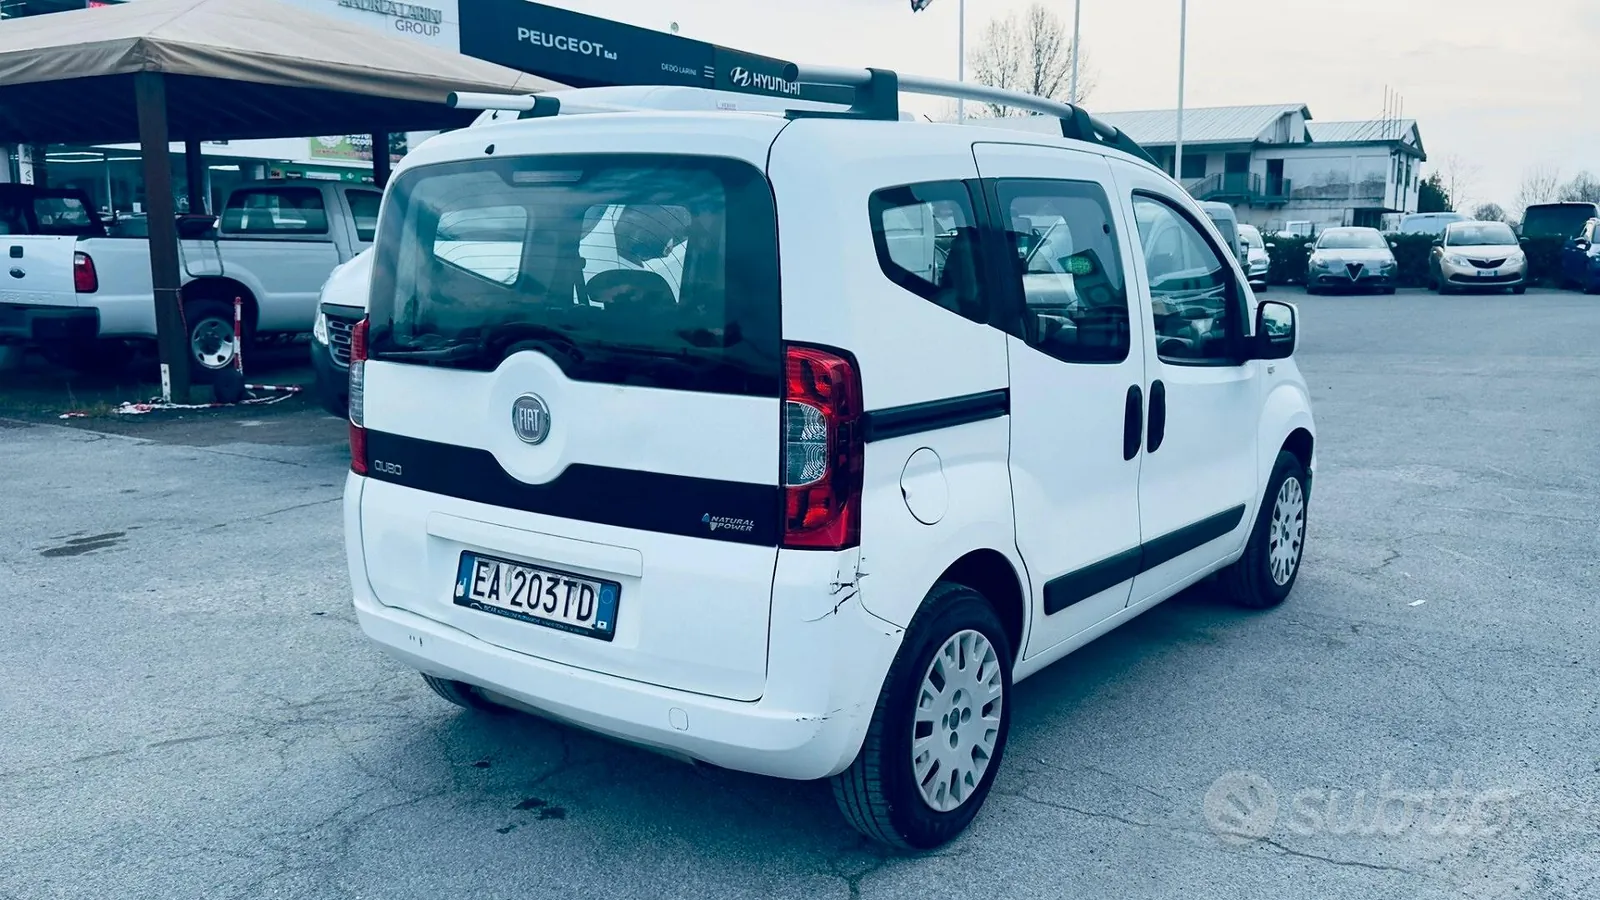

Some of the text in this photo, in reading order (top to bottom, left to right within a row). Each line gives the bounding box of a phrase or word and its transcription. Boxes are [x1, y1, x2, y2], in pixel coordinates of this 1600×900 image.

[395, 19, 440, 36] GROUP
[517, 27, 604, 57] PEUGEOT
[679, 65, 697, 76] LARINI
[519, 407, 540, 432] FIAT
[374, 459, 402, 476] QUBO
[711, 516, 755, 527] NATURAL
[717, 522, 753, 532] POWER
[473, 560, 501, 601] EA
[510, 570, 595, 622] 203TD
